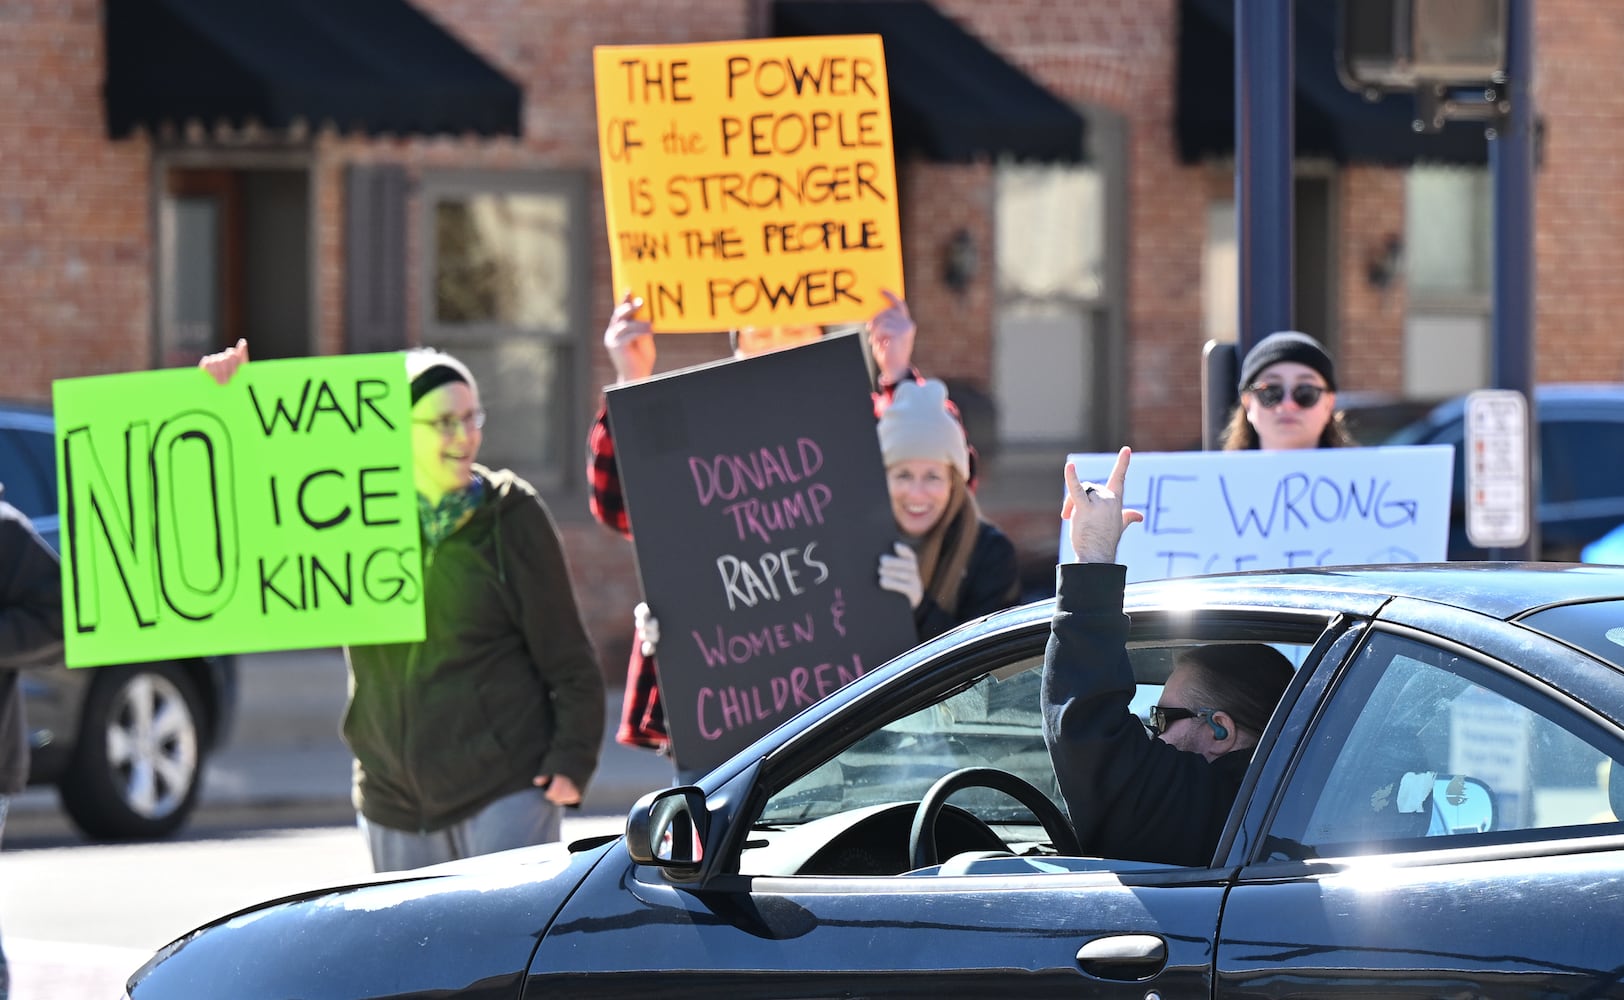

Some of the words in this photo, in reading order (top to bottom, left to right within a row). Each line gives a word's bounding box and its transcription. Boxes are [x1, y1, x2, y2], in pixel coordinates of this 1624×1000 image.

[620, 59, 693, 104] THE
[726, 56, 877, 100] POWER
[607, 118, 643, 163] OF
[662, 120, 706, 155] the
[721, 111, 882, 157] PEOPLE
[628, 177, 654, 217] IS
[666, 161, 886, 217] STRONGER
[680, 229, 745, 260] THE
[763, 220, 884, 255] PEOPLE
[647, 280, 684, 321] IN
[708, 269, 862, 317] POWER
[248, 379, 396, 436] WAR
[270, 466, 400, 530] ICE
[689, 437, 823, 506] DONALD
[63, 408, 239, 633] NO
[723, 482, 833, 543] TRUMP
[1080, 474, 1197, 534] HE
[1218, 472, 1418, 538] WRONG
[258, 546, 422, 615] KINGS
[716, 541, 829, 611] RAPES
[691, 613, 814, 668] WOMEN
